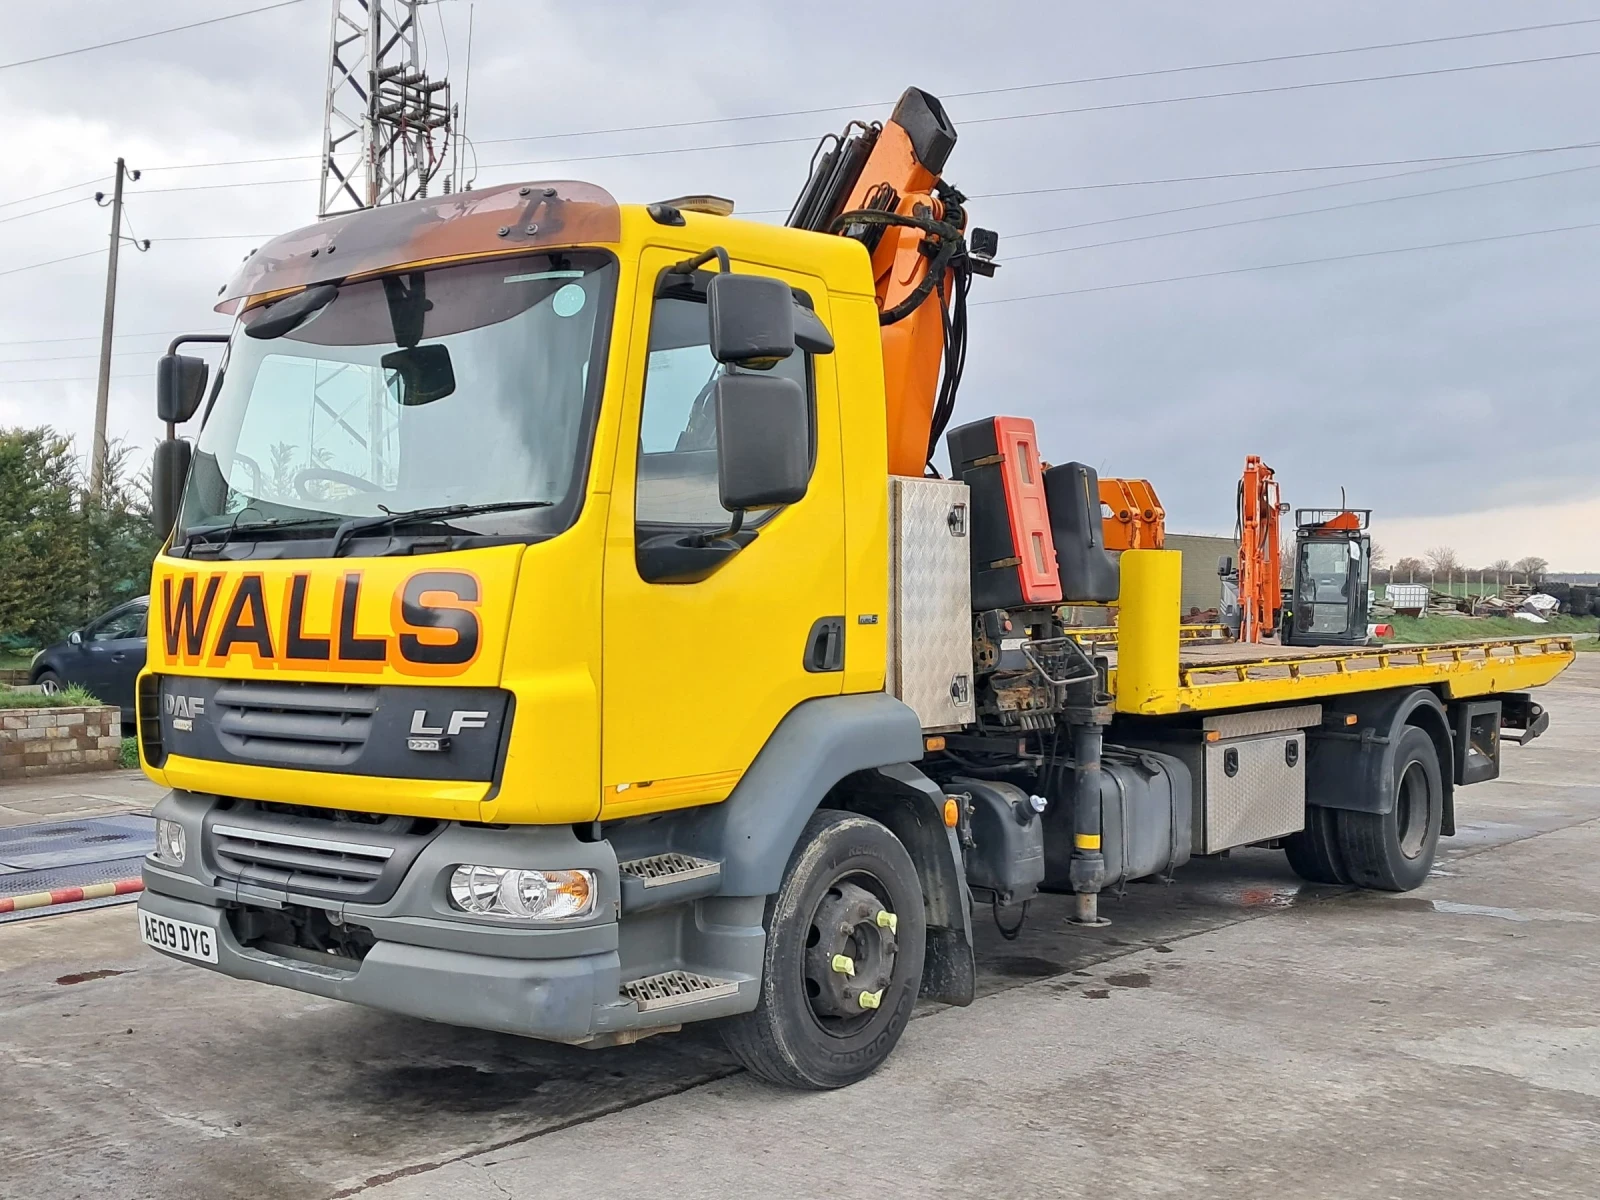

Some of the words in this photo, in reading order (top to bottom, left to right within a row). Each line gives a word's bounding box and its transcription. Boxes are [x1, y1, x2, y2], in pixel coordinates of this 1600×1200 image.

[161, 568, 482, 677] WALLS
[164, 693, 205, 718] DAF
[410, 709, 489, 735] LF
[144, 915, 177, 948] AE09
[179, 925, 210, 956] DYG
